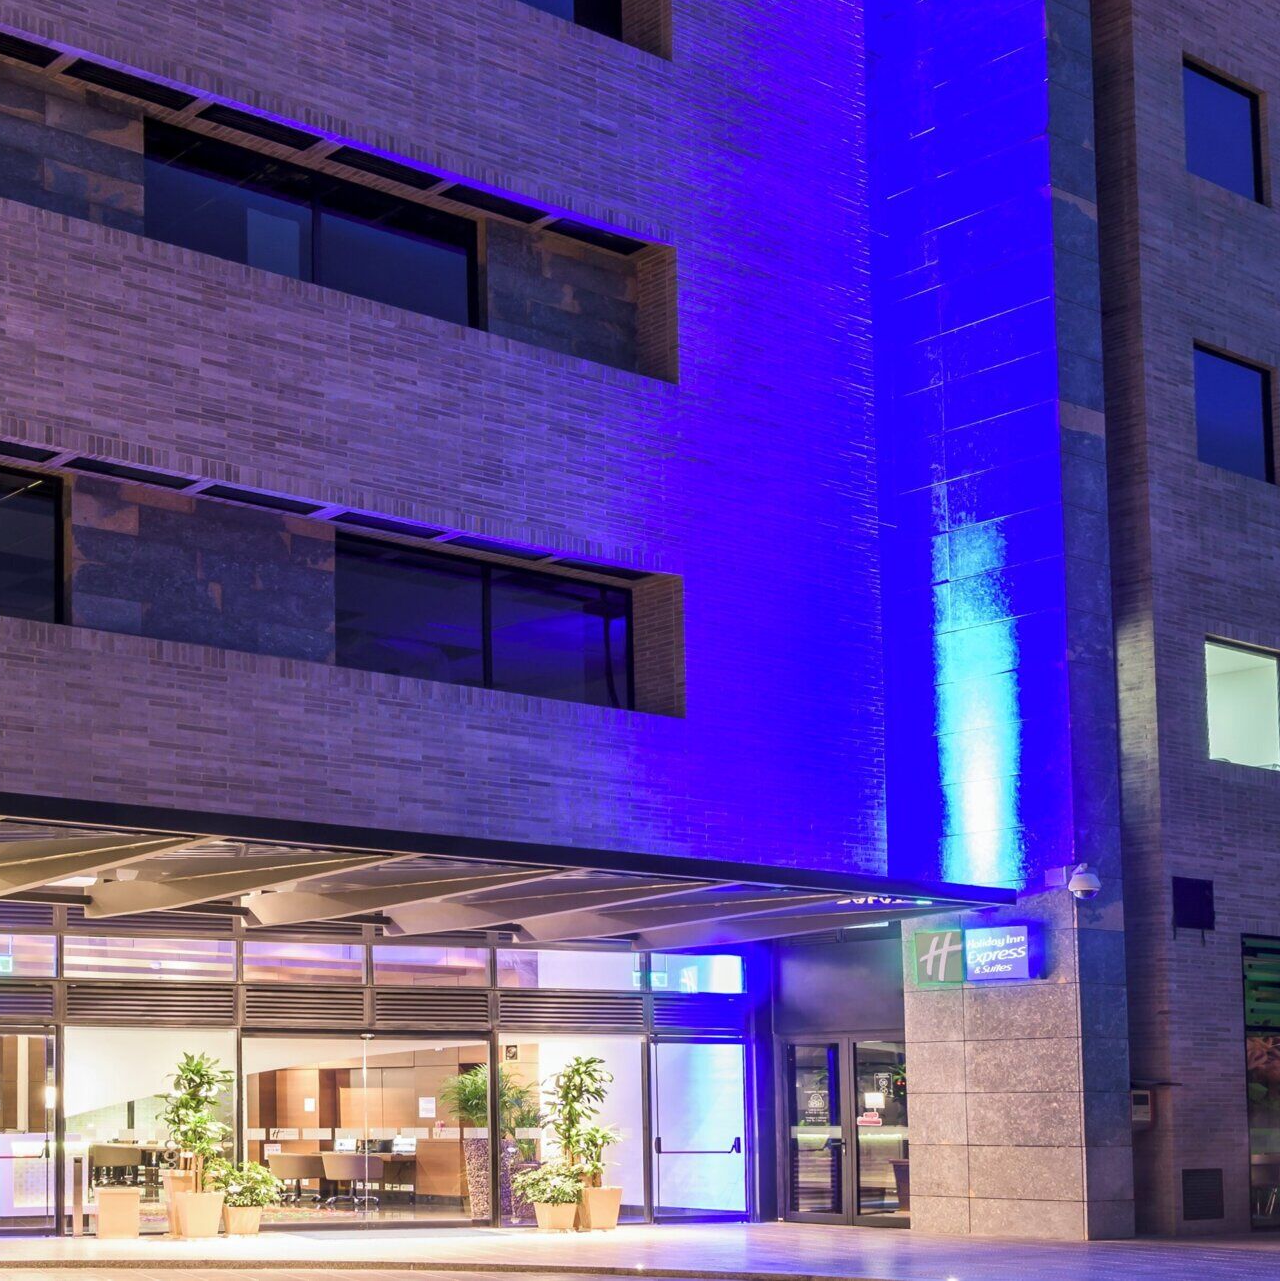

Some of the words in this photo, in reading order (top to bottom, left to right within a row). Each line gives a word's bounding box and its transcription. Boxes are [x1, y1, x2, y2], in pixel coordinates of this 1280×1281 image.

[966, 935, 1005, 949] Holiday
[1006, 934, 1025, 944] Inn
[920, 932, 962, 981] H
[968, 945, 1026, 965] Express
[981, 963, 1013, 974] Suites
